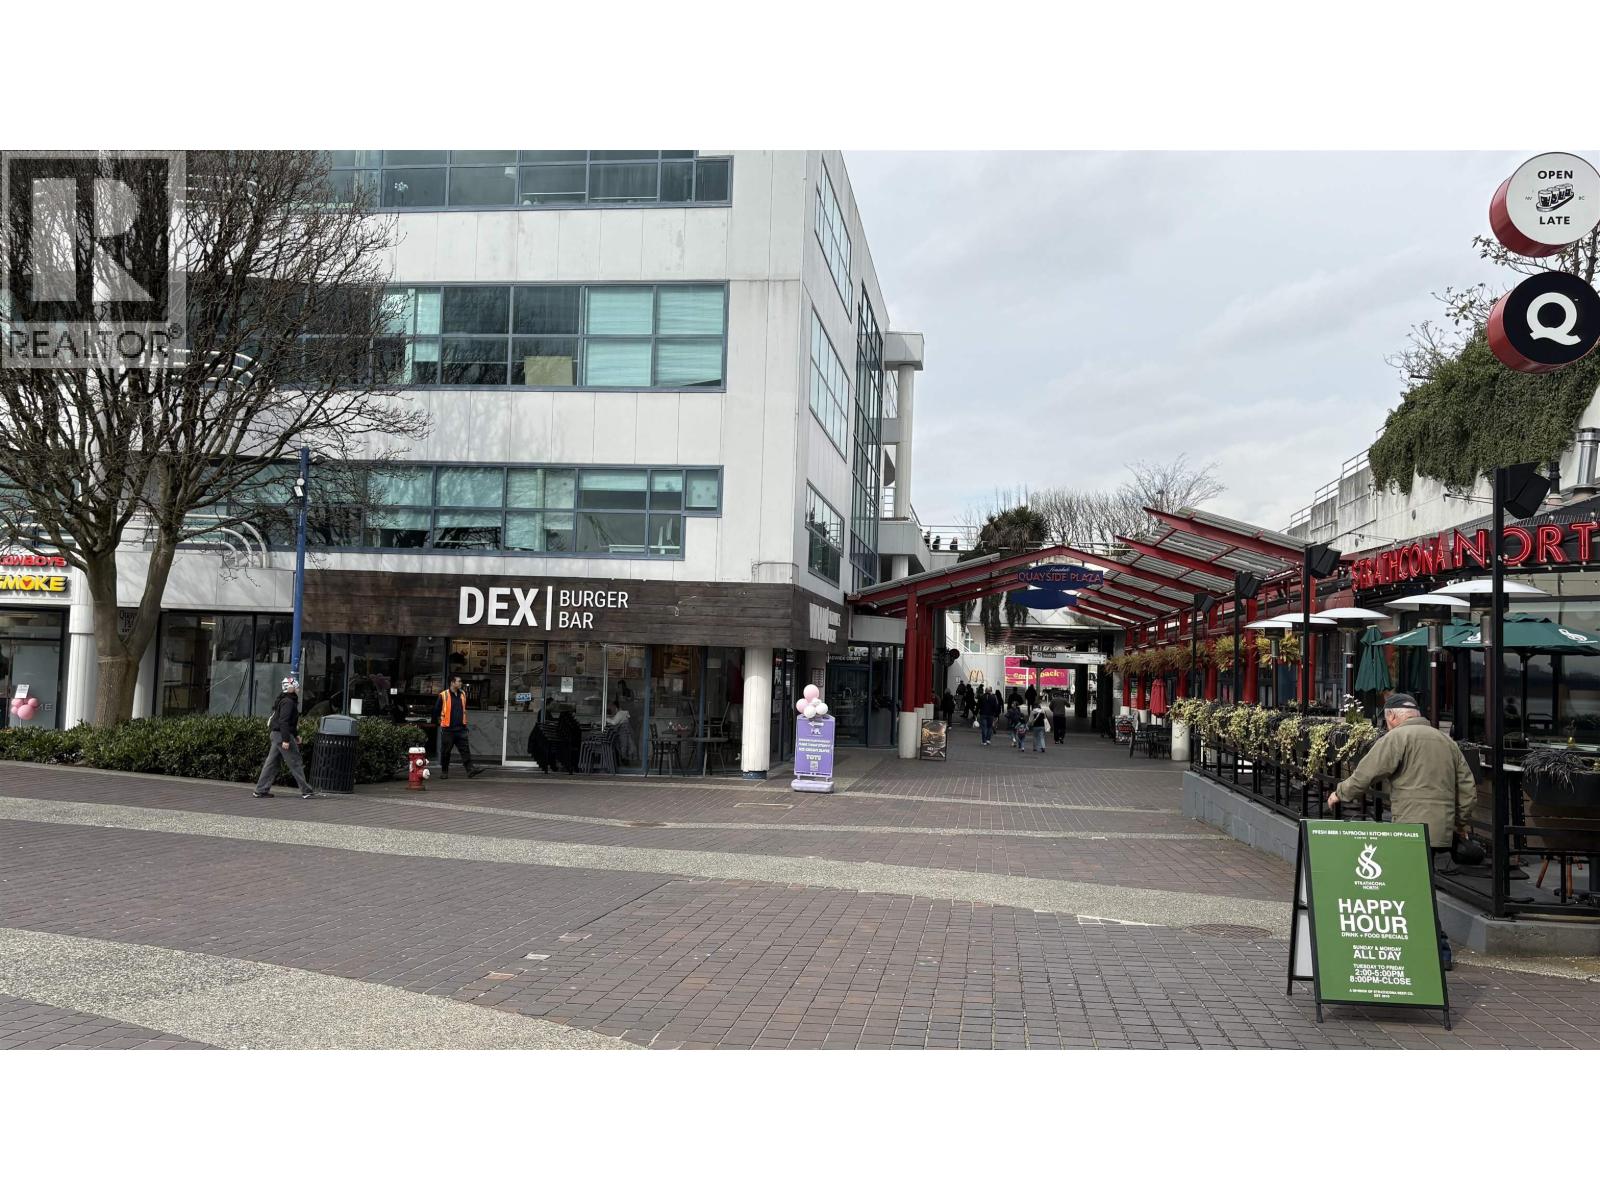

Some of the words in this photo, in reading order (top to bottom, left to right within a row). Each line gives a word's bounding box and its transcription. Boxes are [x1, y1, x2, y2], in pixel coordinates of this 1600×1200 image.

[1537, 170, 1573, 179] OPEN
[1539, 216, 1570, 225] LATE
[1526, 292, 1582, 346] Q
[1019, 572, 1067, 582] QUAYSIDE
[1070, 573, 1102, 583] PLAZA
[459, 586, 539, 626] DEX
[559, 590, 629, 608] BURGER
[558, 611, 594, 629] BAR
[1338, 898, 1405, 915] HAPPY
[1340, 914, 1408, 933] HOUR
[1354, 950, 1376, 959] ALL
[1379, 951, 1401, 960] DAY
[1355, 969, 1404, 977] 2:00-5:00PM
[1350, 976, 1411, 985] 8:00PM-CLOSE
